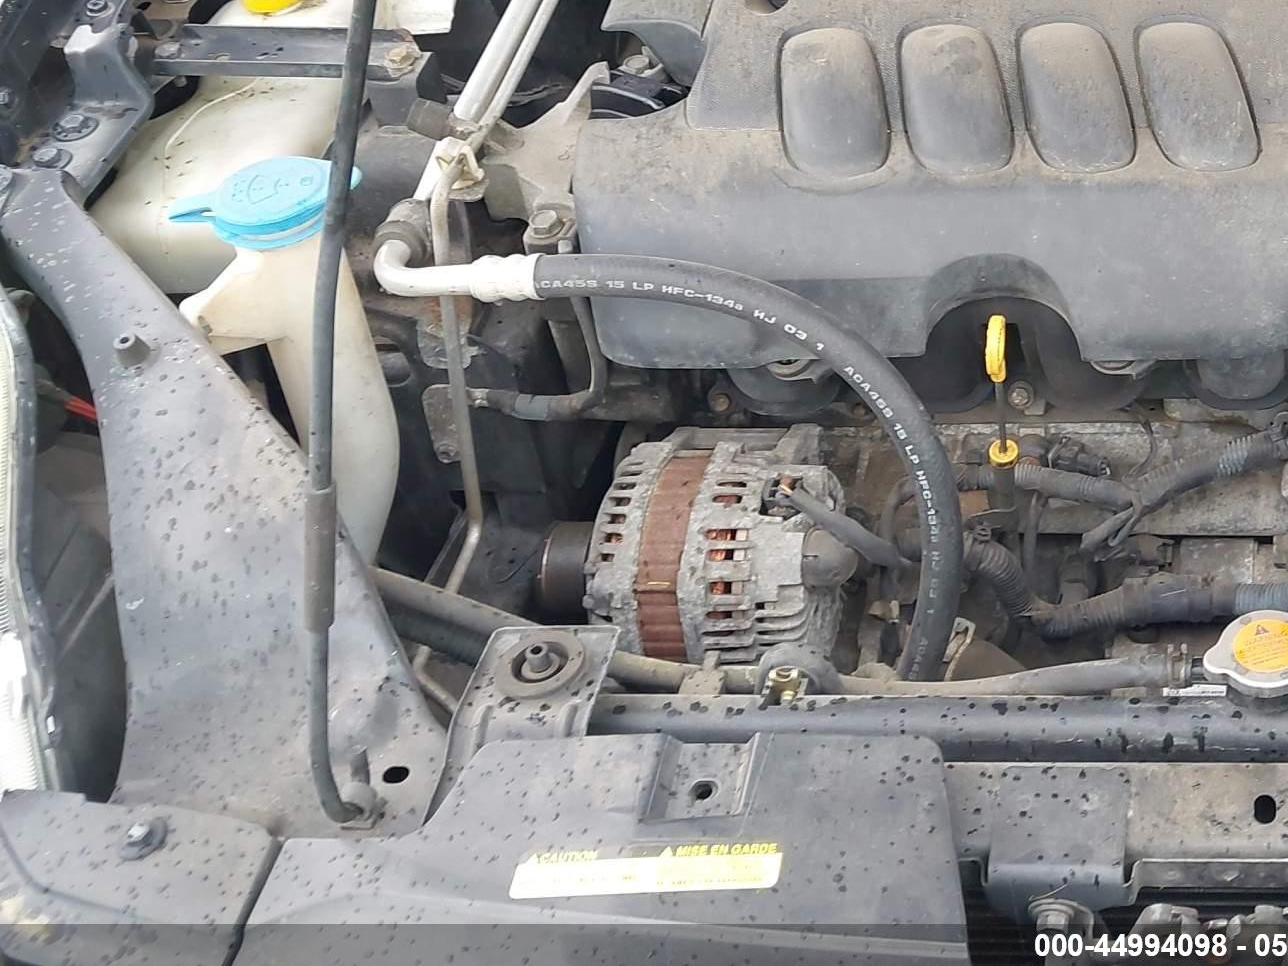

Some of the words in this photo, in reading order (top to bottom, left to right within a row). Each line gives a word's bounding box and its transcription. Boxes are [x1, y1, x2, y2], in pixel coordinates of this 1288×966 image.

[605, 280, 625, 289] 15
[632, 281, 654, 291] LP
[661, 285, 744, 311] HFC-134a
[752, 309, 777, 324] HJ
[893, 422, 908, 440] 15
[904, 444, 920, 464] LP
[675, 844, 709, 857] MISE
[710, 844, 730, 855] EN
[731, 843, 777, 855] GARDE
